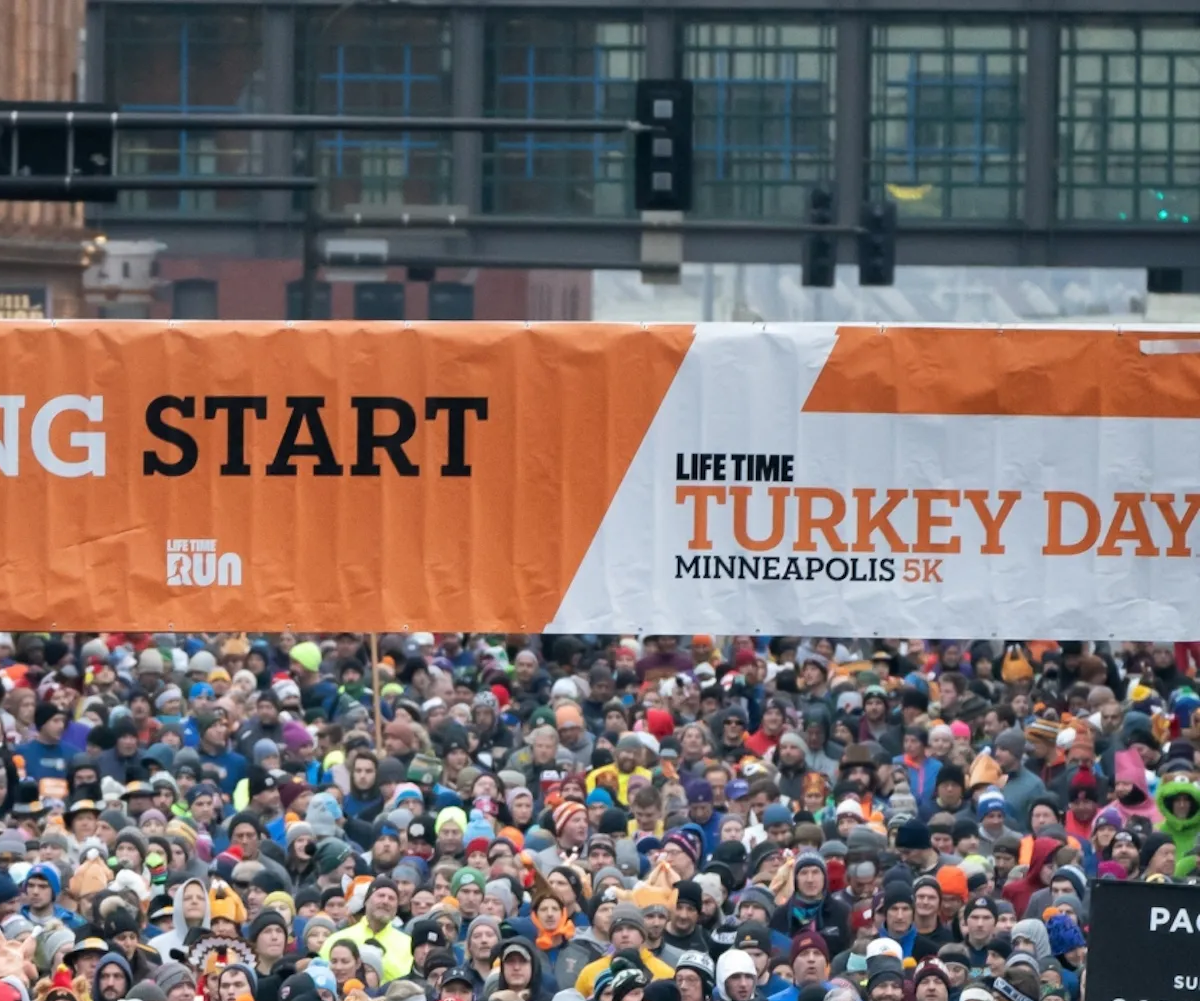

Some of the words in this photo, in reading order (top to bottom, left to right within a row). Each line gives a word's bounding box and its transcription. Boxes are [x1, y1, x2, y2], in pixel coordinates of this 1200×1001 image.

[142, 394, 489, 478] START
[676, 453, 726, 482] LIFE
[731, 453, 794, 482] TIME
[675, 485, 1021, 555] TURKEY
[1043, 491, 1199, 557] DAY
[166, 539, 188, 552] LIFE
[190, 539, 217, 552] TIME
[166, 552, 242, 587] RUN
[675, 556, 895, 582] MINNEAPOLIS
[902, 558, 944, 583] 5K
